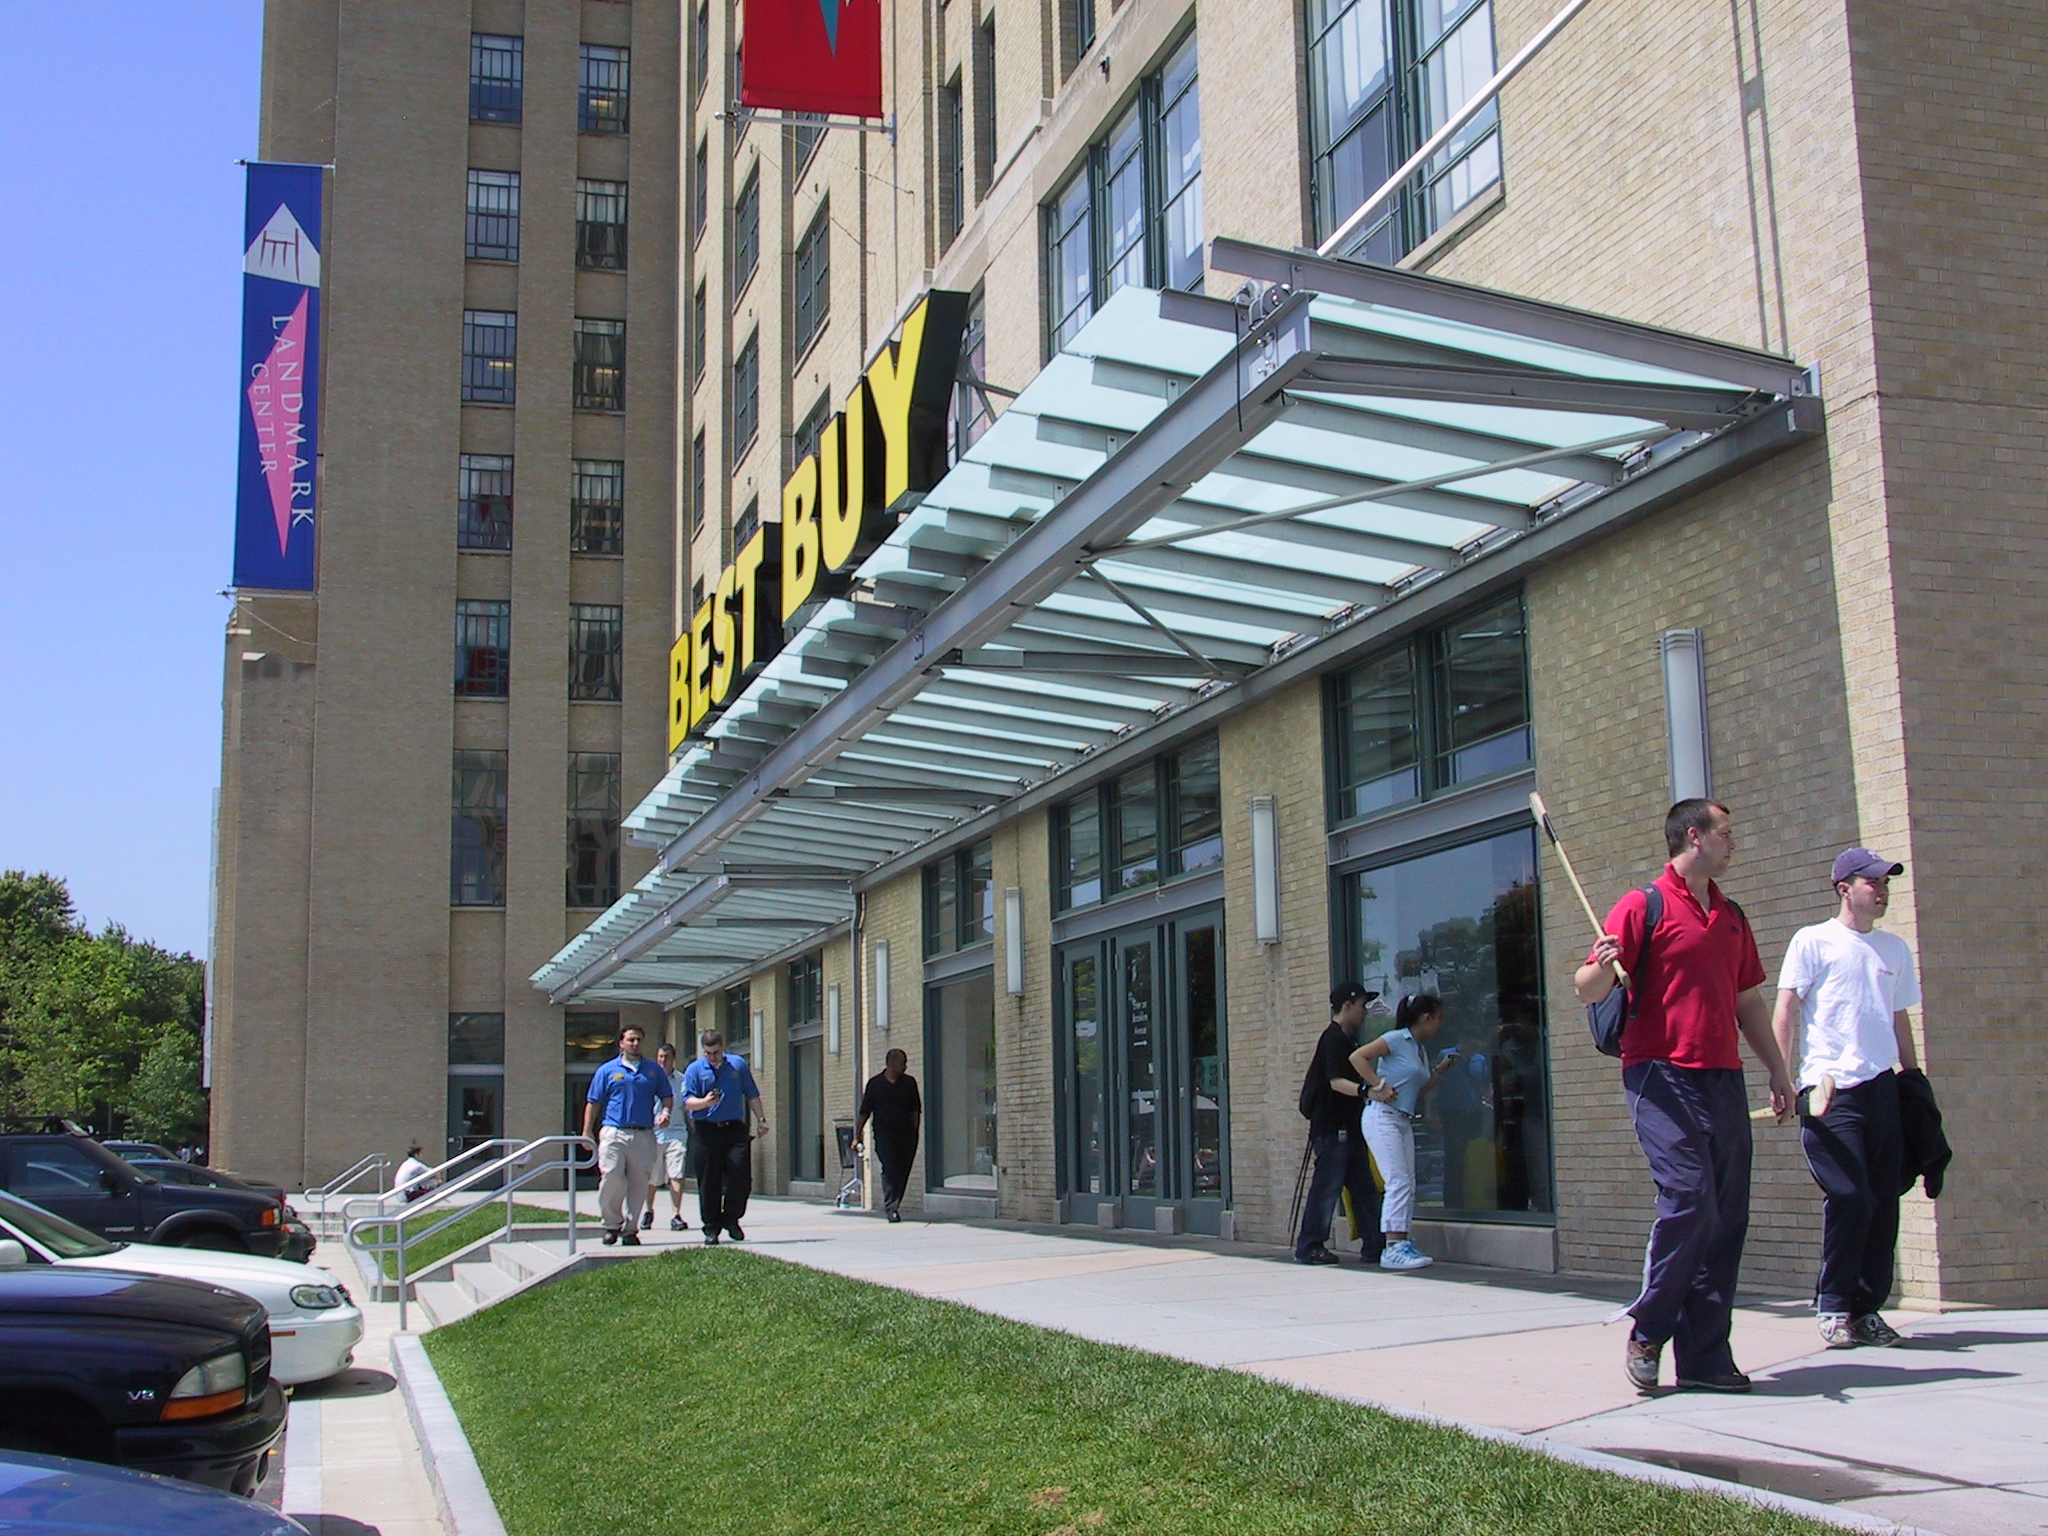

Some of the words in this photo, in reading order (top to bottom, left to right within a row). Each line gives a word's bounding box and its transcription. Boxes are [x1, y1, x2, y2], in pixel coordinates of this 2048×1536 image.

[251, 363, 278, 475] CENTER
[272, 315, 314, 527] LANDMARK
[669, 526, 765, 754] BEST
[781, 296, 930, 623] BUY
[127, 1389, 155, 1401] V8
